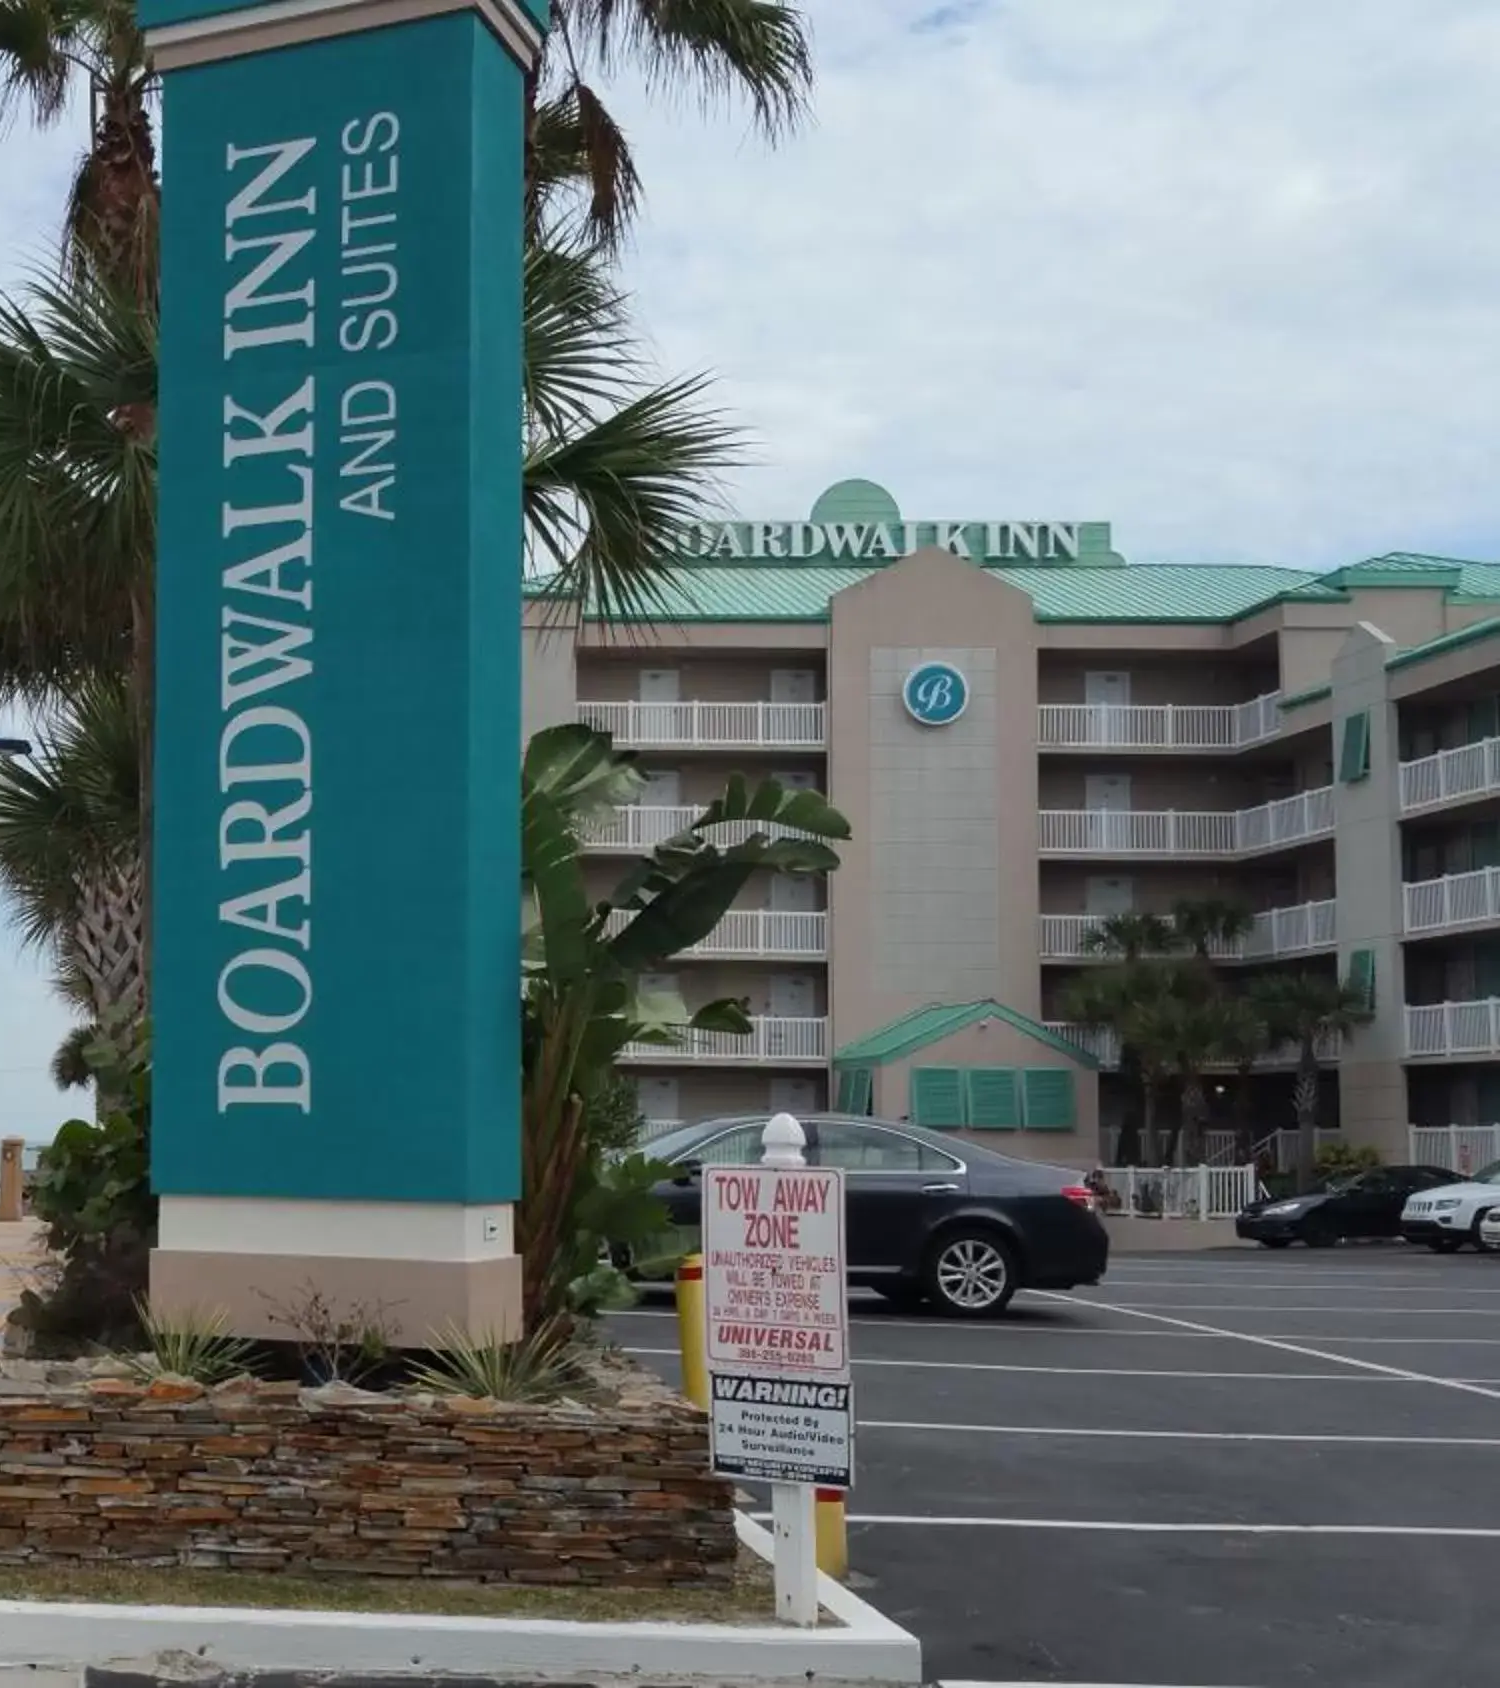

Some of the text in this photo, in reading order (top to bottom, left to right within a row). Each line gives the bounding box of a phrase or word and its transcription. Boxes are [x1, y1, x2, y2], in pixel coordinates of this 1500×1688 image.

[339, 110, 400, 520] AND SUITES
[646, 521, 1083, 560] OARDWALK INN
[217, 136, 317, 1114] BOARDWALK INN
[715, 1176, 831, 1214] TOW AWAY
[744, 1213, 800, 1249] ZONE
[710, 1250, 837, 1273] UNAUTHORIZED VEHICLES
[726, 1269, 823, 1291] WILL BE TOWED AT
[775, 1291, 820, 1311] EXPENSE
[717, 1324, 835, 1352] UNIVERSAL
[715, 1377, 847, 1409] WARNING!
[741, 1409, 820, 1430] Protected By
[718, 1422, 845, 1446] 24 Hour Audio/Video
[741, 1439, 816, 1457] Surveillance
